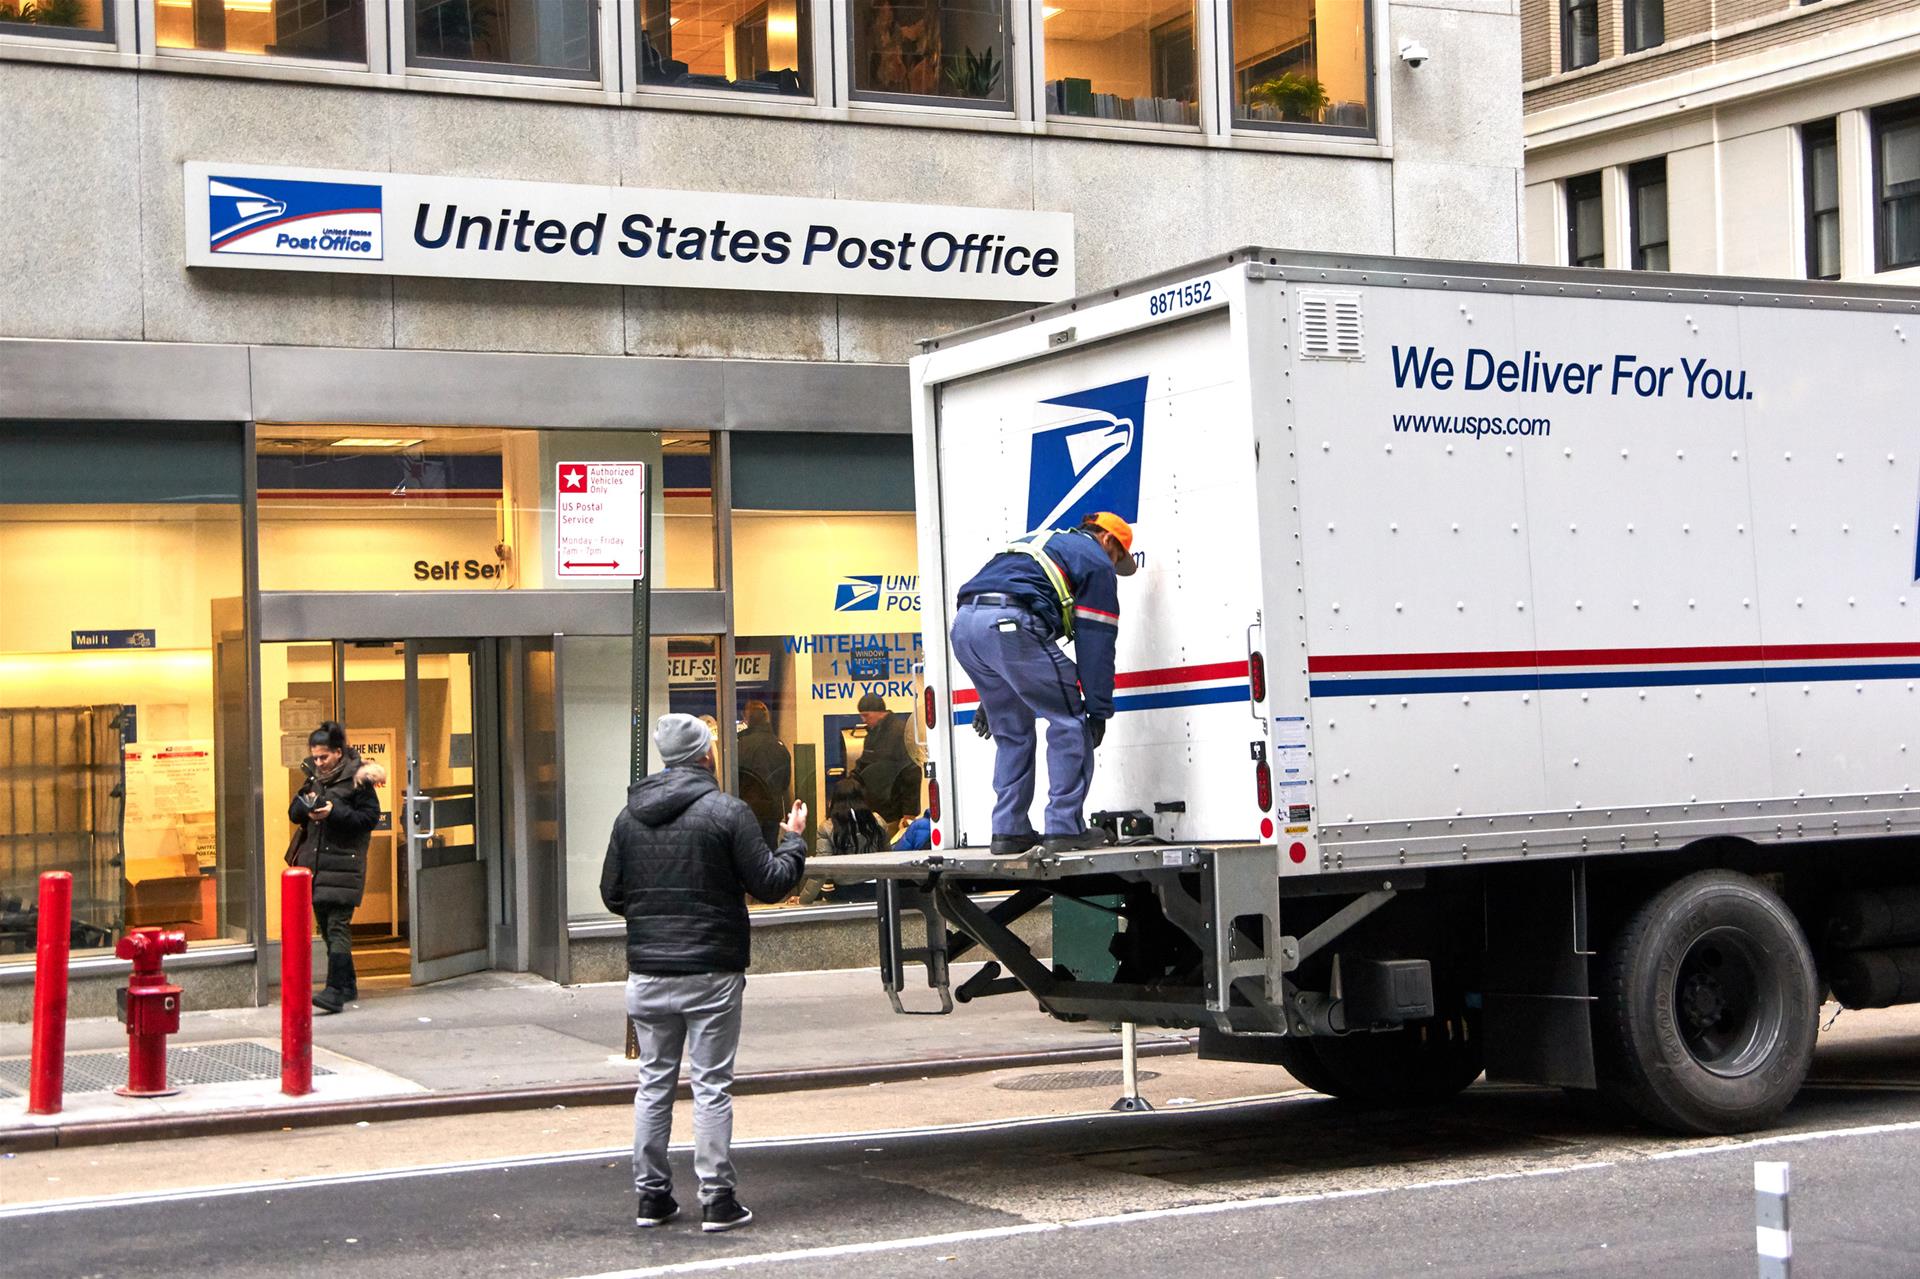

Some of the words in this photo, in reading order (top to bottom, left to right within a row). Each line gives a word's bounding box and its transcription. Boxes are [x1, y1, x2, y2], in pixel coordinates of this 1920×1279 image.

[276, 233, 317, 249] Post
[319, 235, 372, 252] Office
[413, 203, 607, 256] United
[617, 213, 792, 265] States
[802, 224, 916, 271] Post
[920, 231, 1060, 278] Office
[1150, 280, 1212, 316] 8871552
[1391, 345, 1454, 390] We
[1464, 348, 1602, 395] Deliver
[1611, 354, 1674, 397] For
[1680, 357, 1753, 400] You.
[1392, 414, 1551, 440] www.usps.com
[590, 468, 635, 476] Authorized
[590, 476, 624, 485] Vehicles
[590, 485, 608, 494] Only
[562, 502, 574, 511] US
[576, 502, 603, 511] Postal
[562, 515, 594, 524] Service
[562, 536, 592, 545] Monday
[600, 536, 625, 545] Friday
[563, 547, 578, 555] 7am
[586, 546, 602, 555] 7pm
[414, 560, 459, 581] Self
[886, 575, 920, 591] UNI
[76, 635, 98, 645] Mail
[102, 635, 109, 645] it
[783, 633, 906, 654] WHITEHALL
[831, 660, 838, 676] 1
[812, 683, 855, 700] NEW
[353, 744, 366, 754] THE
[368, 743, 386, 754] NEW
